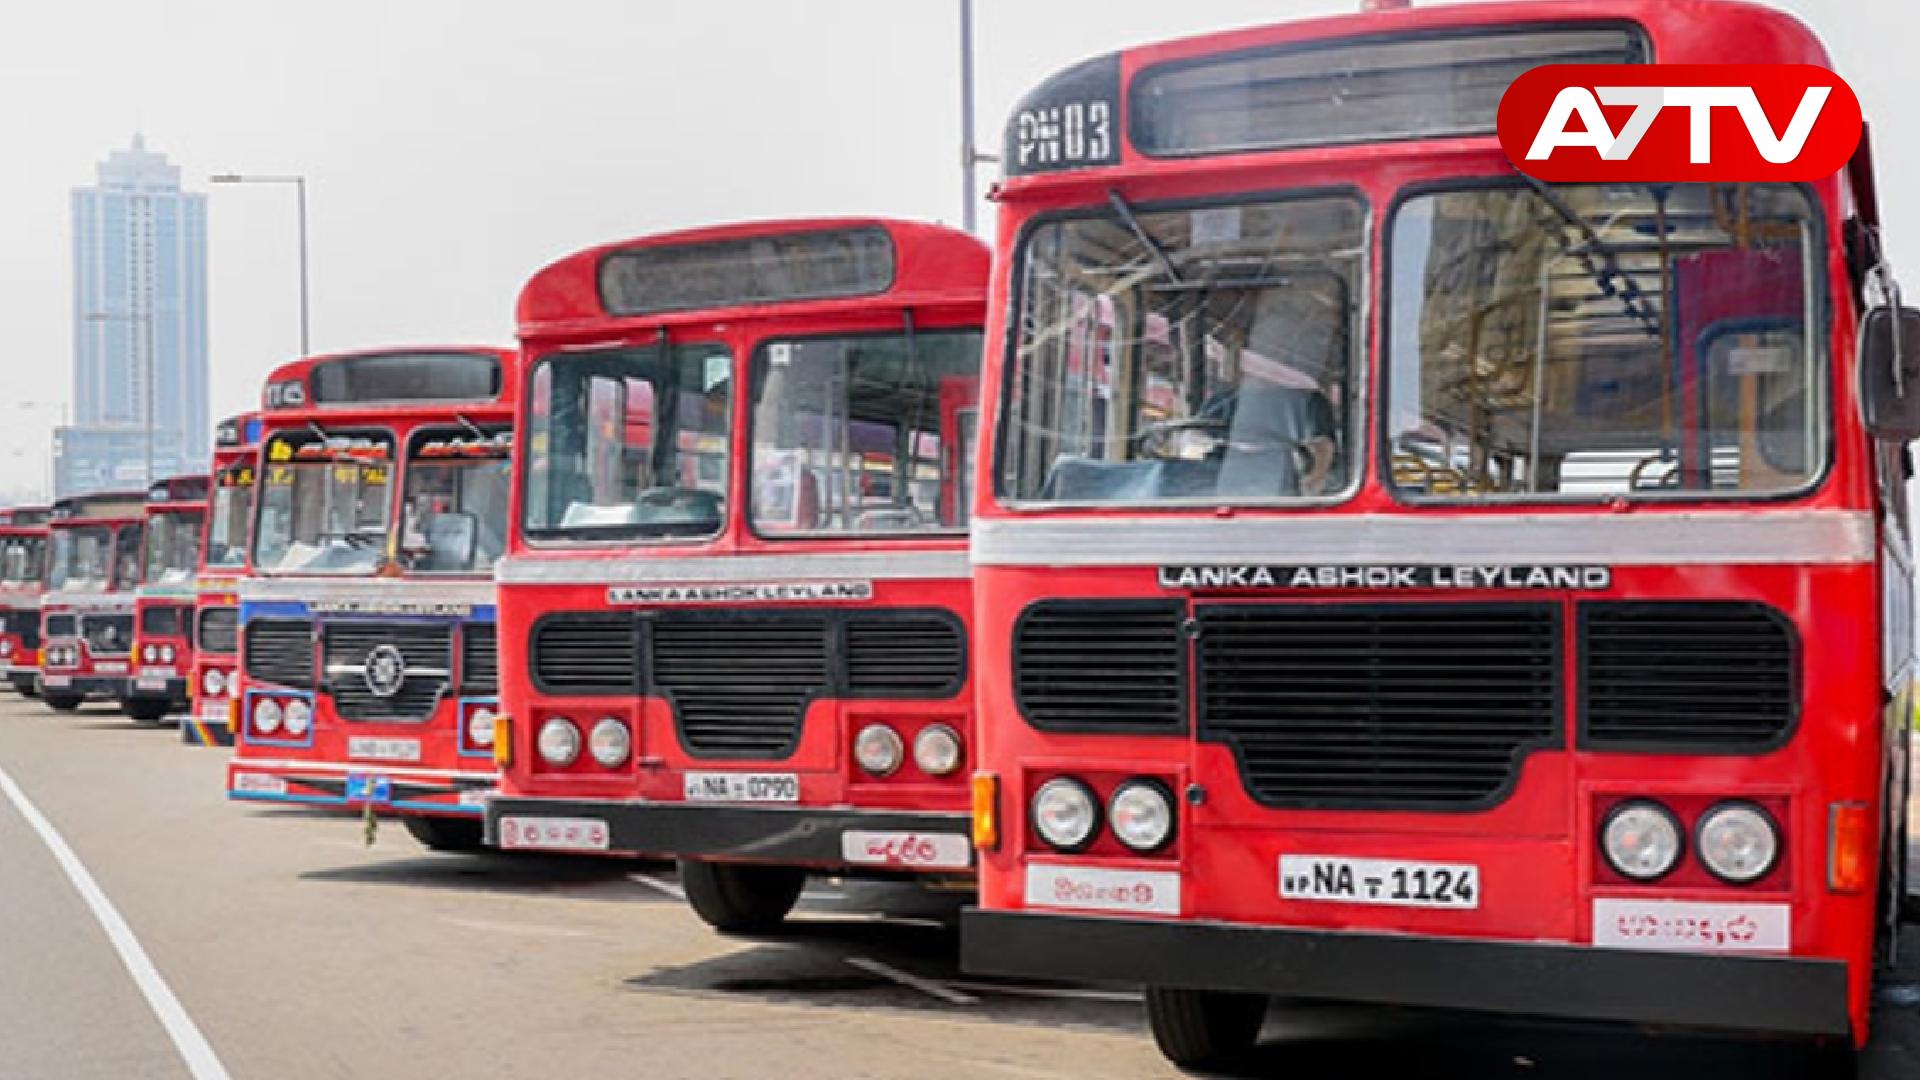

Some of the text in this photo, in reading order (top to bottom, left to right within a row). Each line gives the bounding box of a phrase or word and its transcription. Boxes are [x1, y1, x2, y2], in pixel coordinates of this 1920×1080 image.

[1158, 567, 1610, 588] LANKA ASHOK LEYLAND
[1313, 862, 1355, 896] NA
[1391, 867, 1474, 902] 1124
